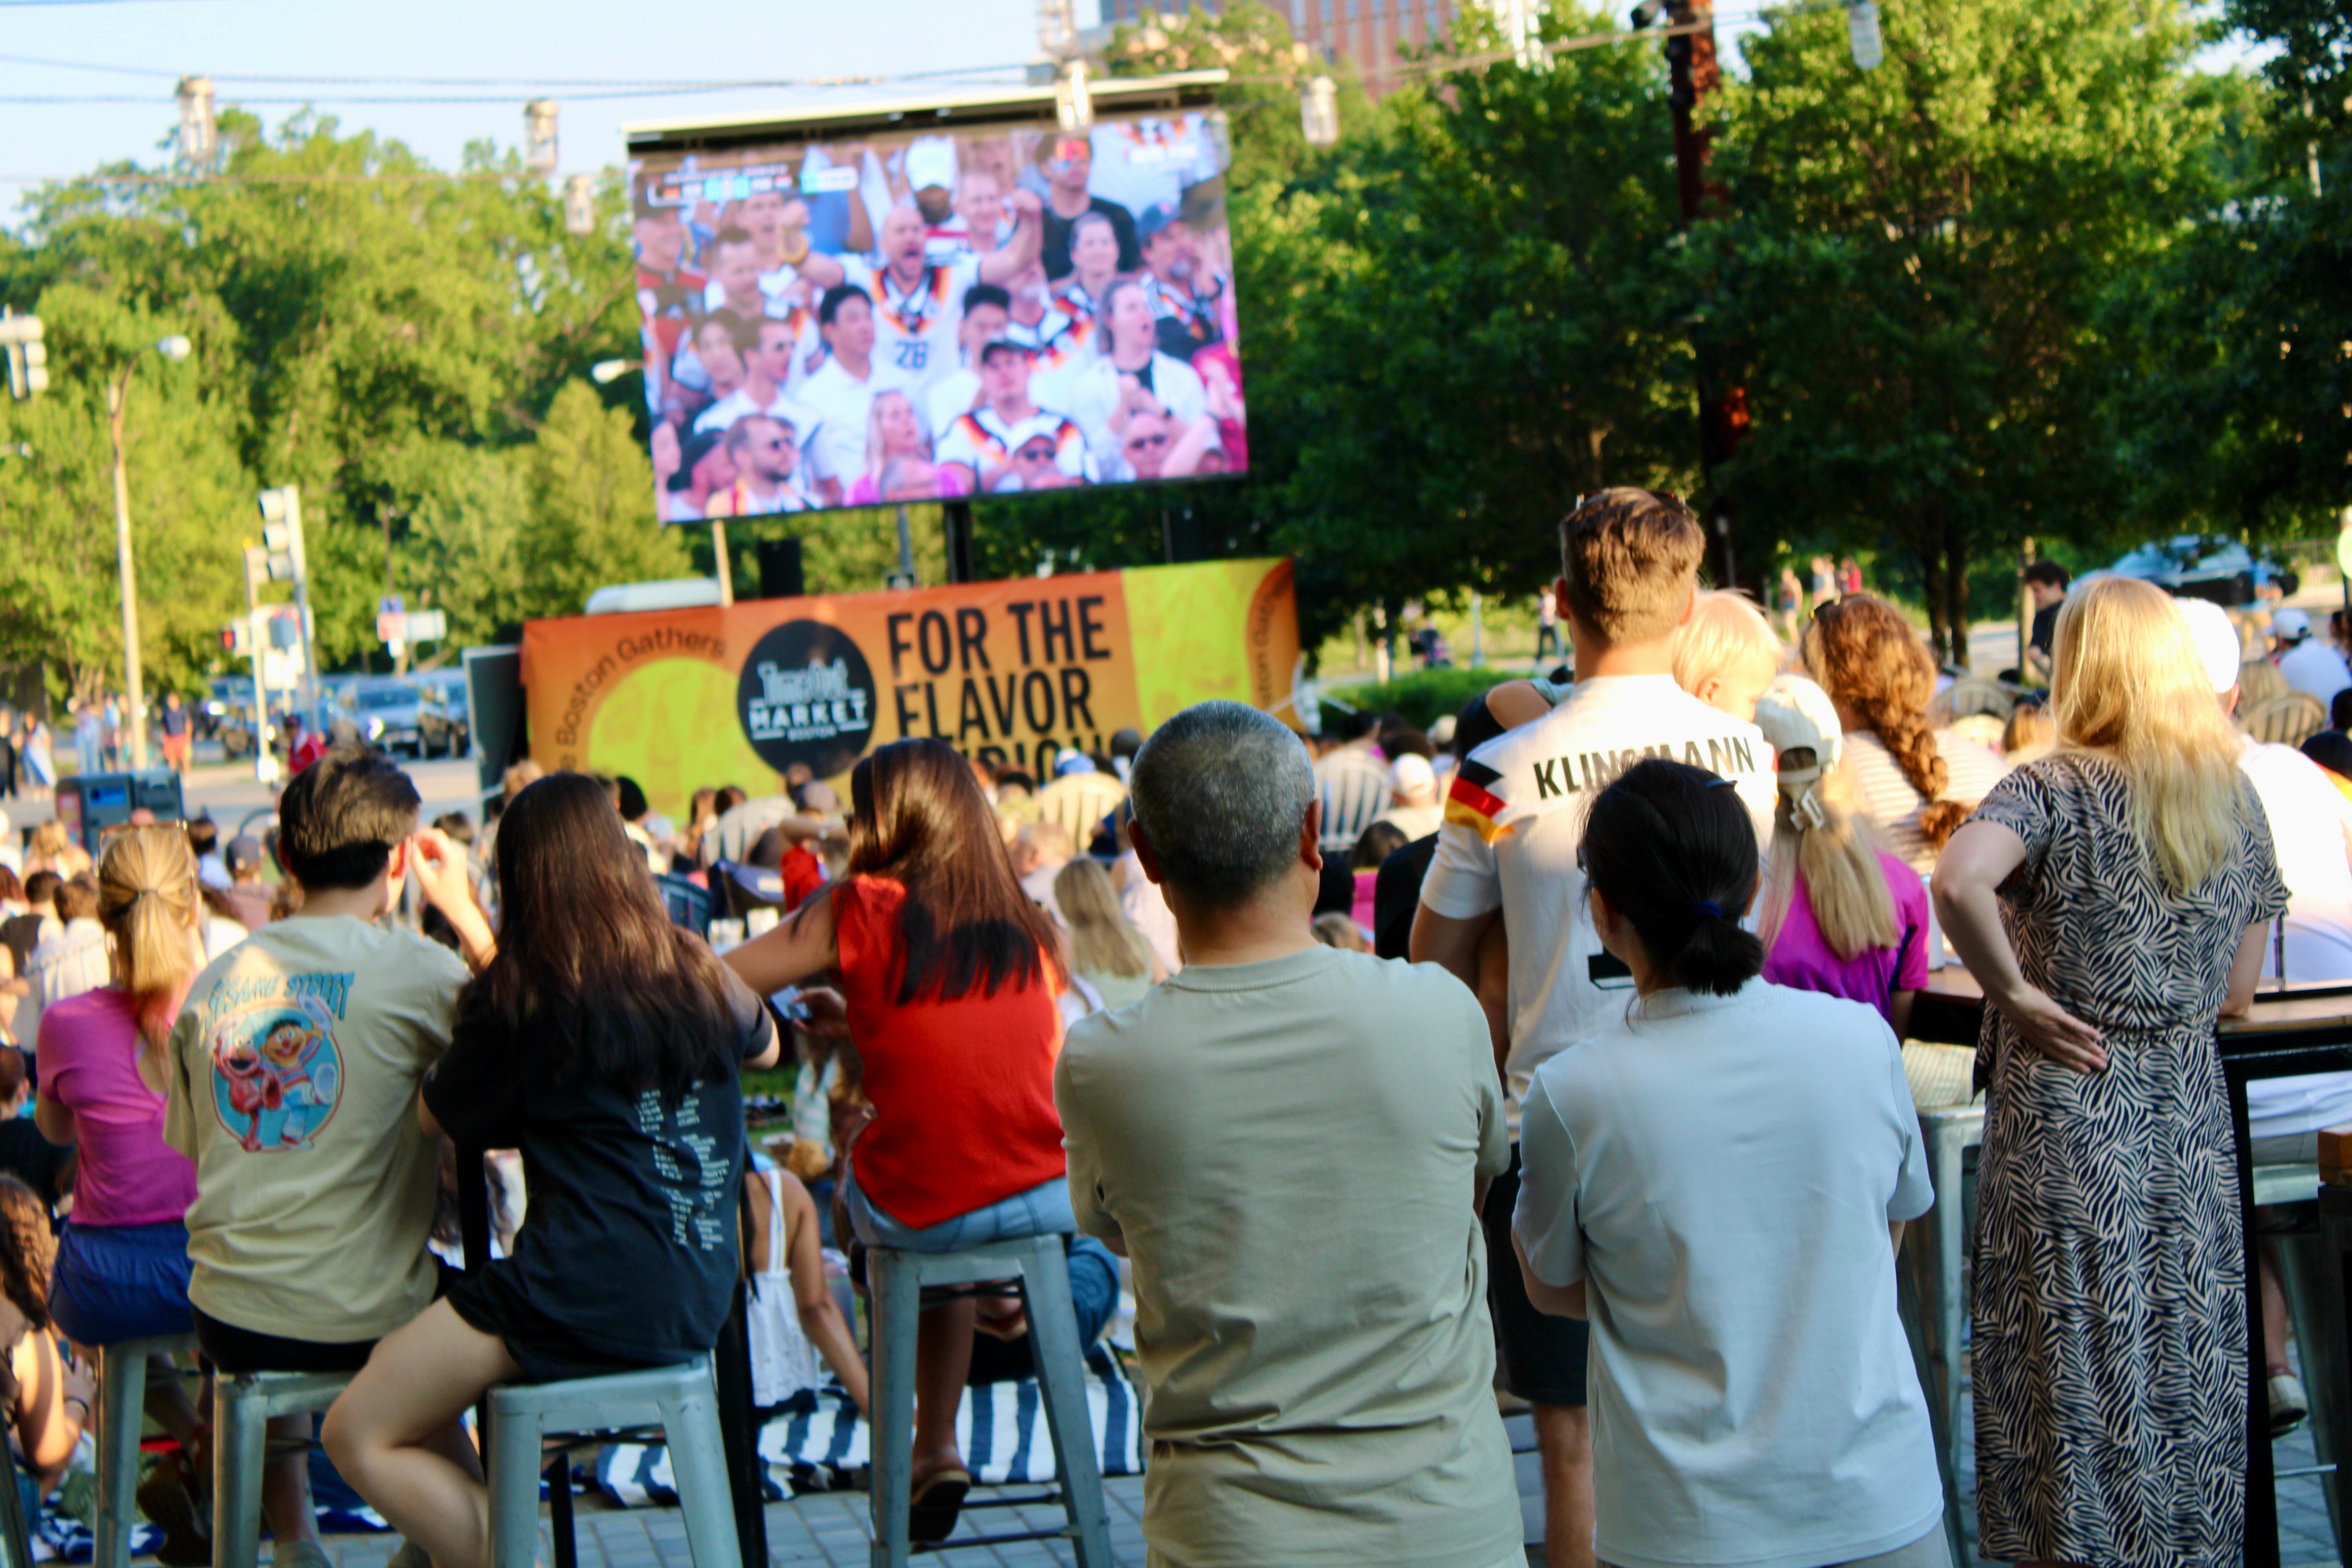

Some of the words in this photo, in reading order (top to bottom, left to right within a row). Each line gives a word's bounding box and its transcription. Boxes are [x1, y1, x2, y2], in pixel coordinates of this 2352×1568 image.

[887, 607, 991, 679] FOR
[1007, 595, 1110, 664] THE
[555, 656, 616, 746] Boston
[617, 627, 726, 662] Gathers
[749, 700, 866, 730] MARKET
[895, 668, 1095, 742] FLAVOR
[285, 970, 356, 1020] STREET
